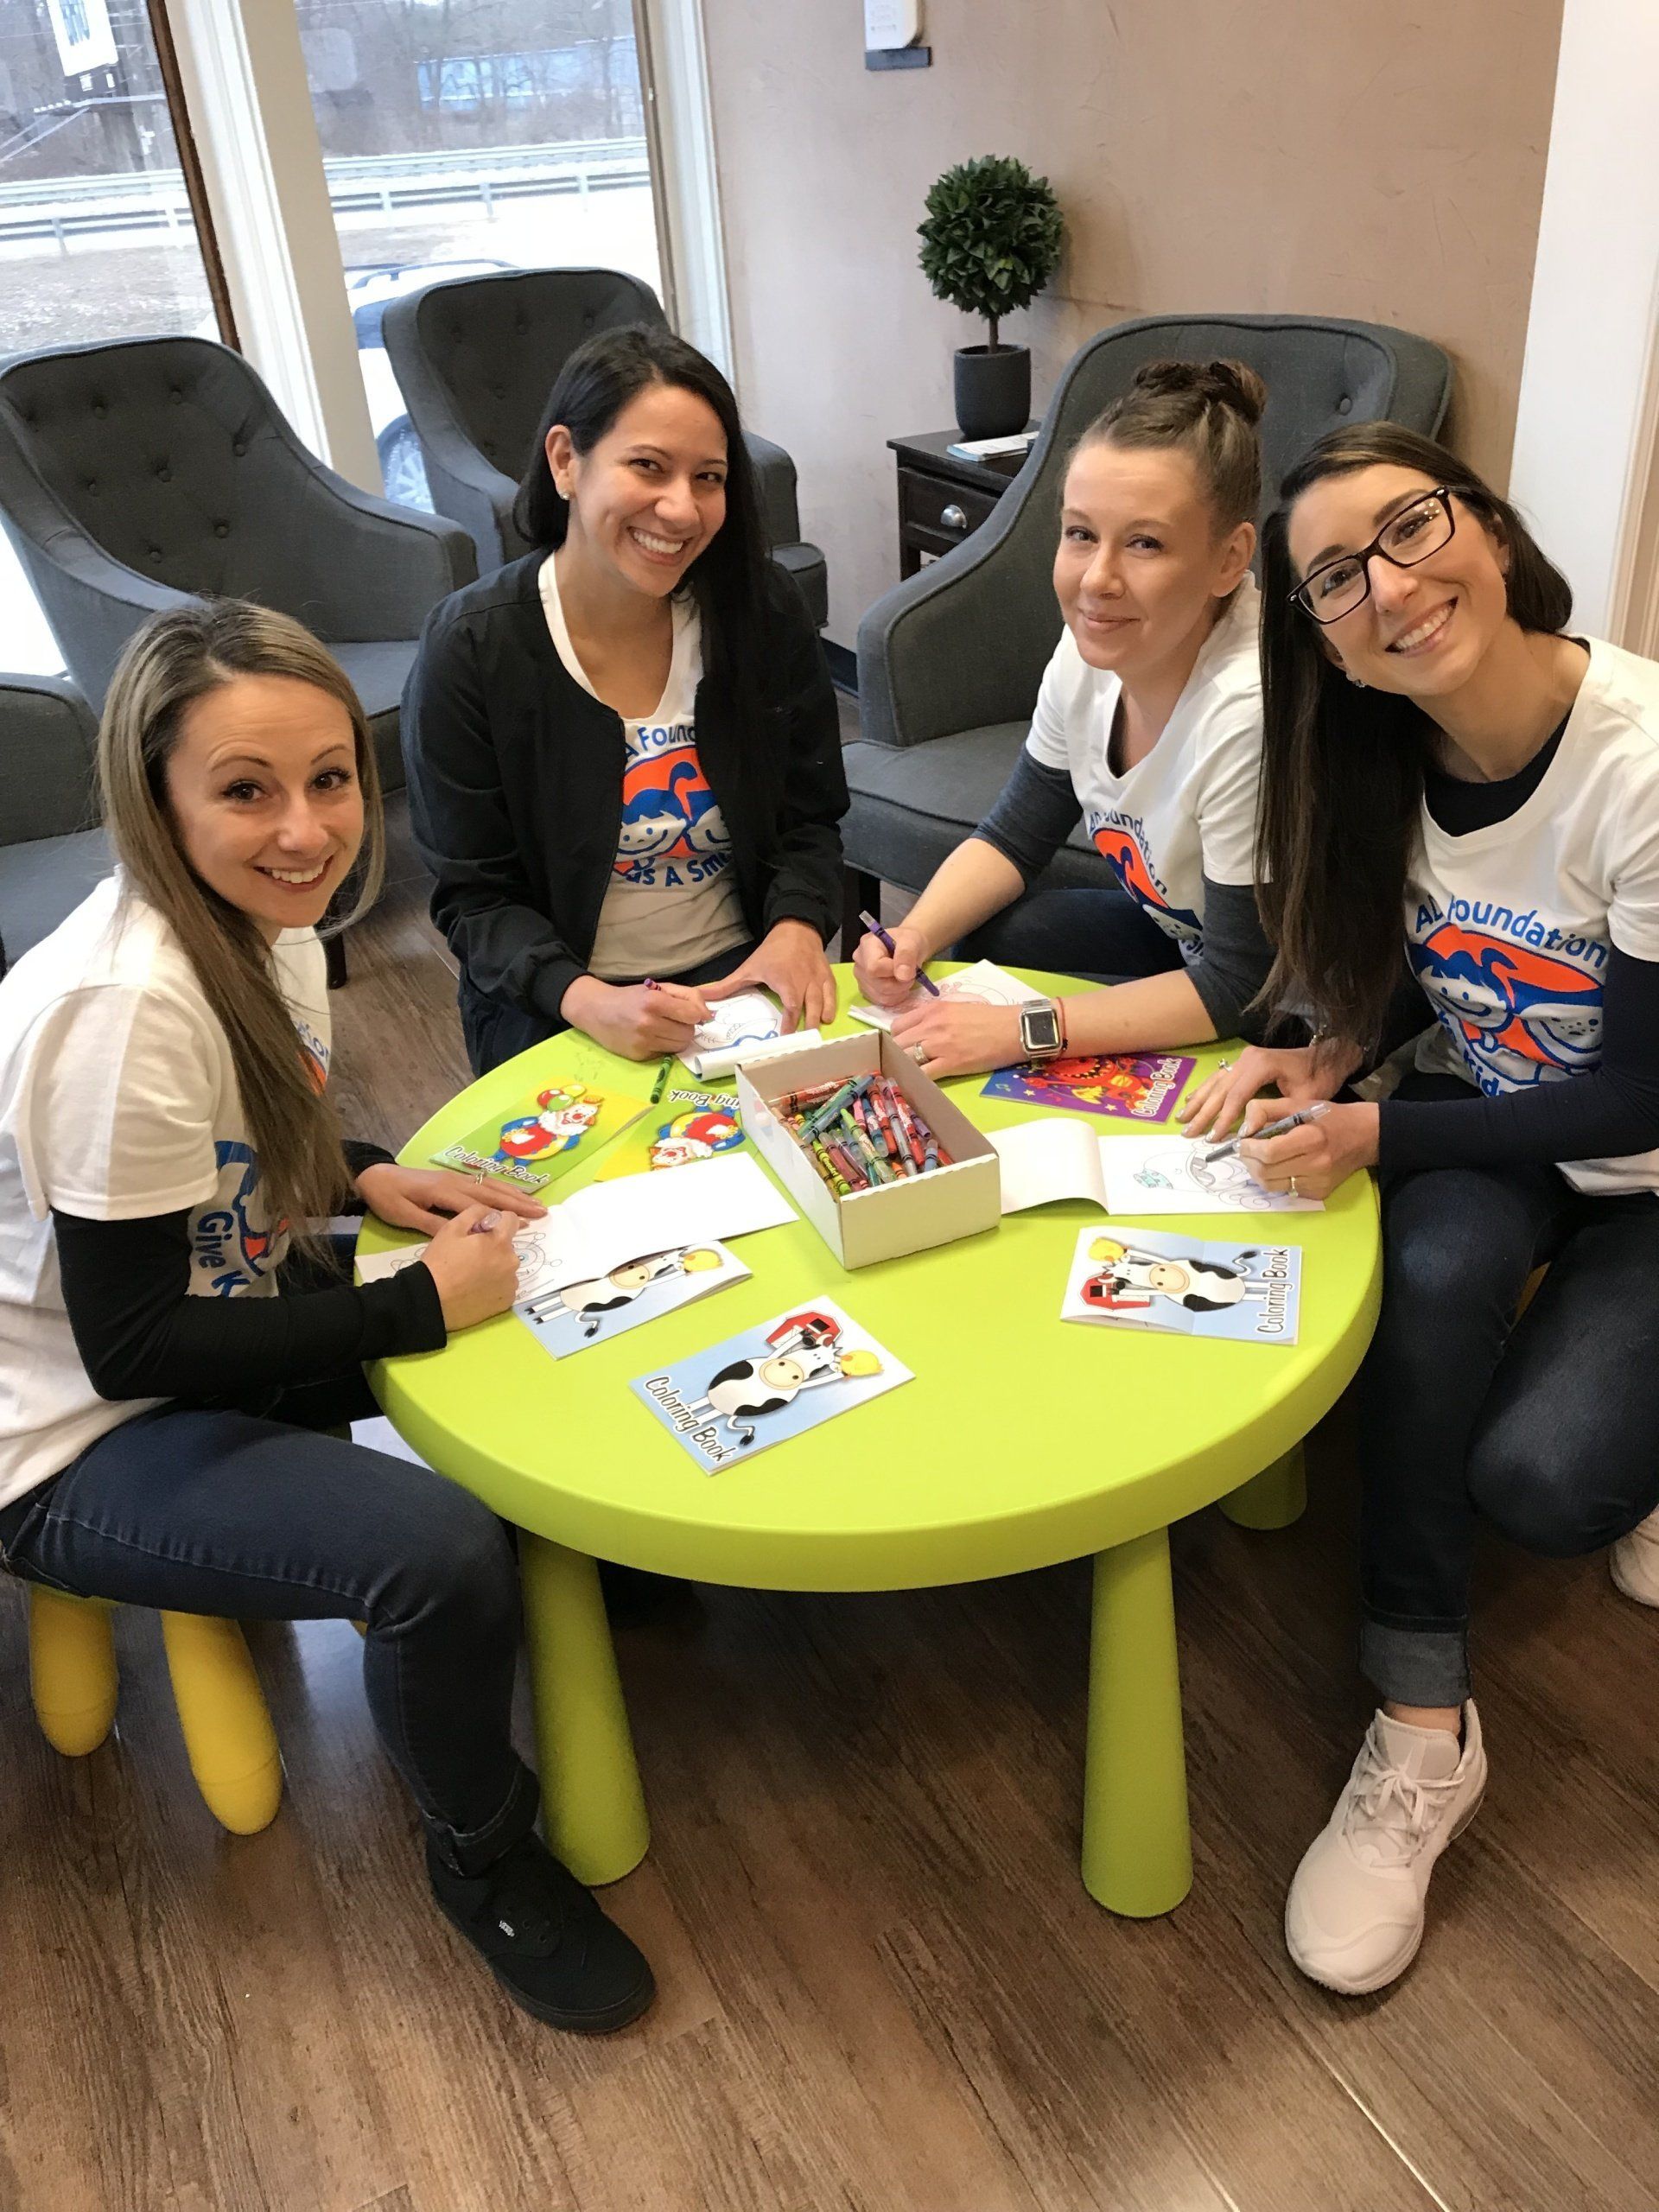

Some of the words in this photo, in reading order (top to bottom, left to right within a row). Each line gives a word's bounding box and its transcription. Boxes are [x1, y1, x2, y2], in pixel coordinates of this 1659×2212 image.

[664, 865, 684, 887] A
[1152, 1058, 1181, 1080] Book
[670, 1090, 710, 1106] Book
[1132, 1082, 1175, 1116] Coloring
[444, 1146, 507, 1174] Coloring
[506, 1166, 548, 1184] Book
[194, 1211, 234, 1269] Give
[1262, 1249, 1289, 1279] Book
[1256, 1283, 1294, 1333] Coloring
[645, 1376, 701, 1433] Coloring
[691, 1427, 737, 1462] Book
